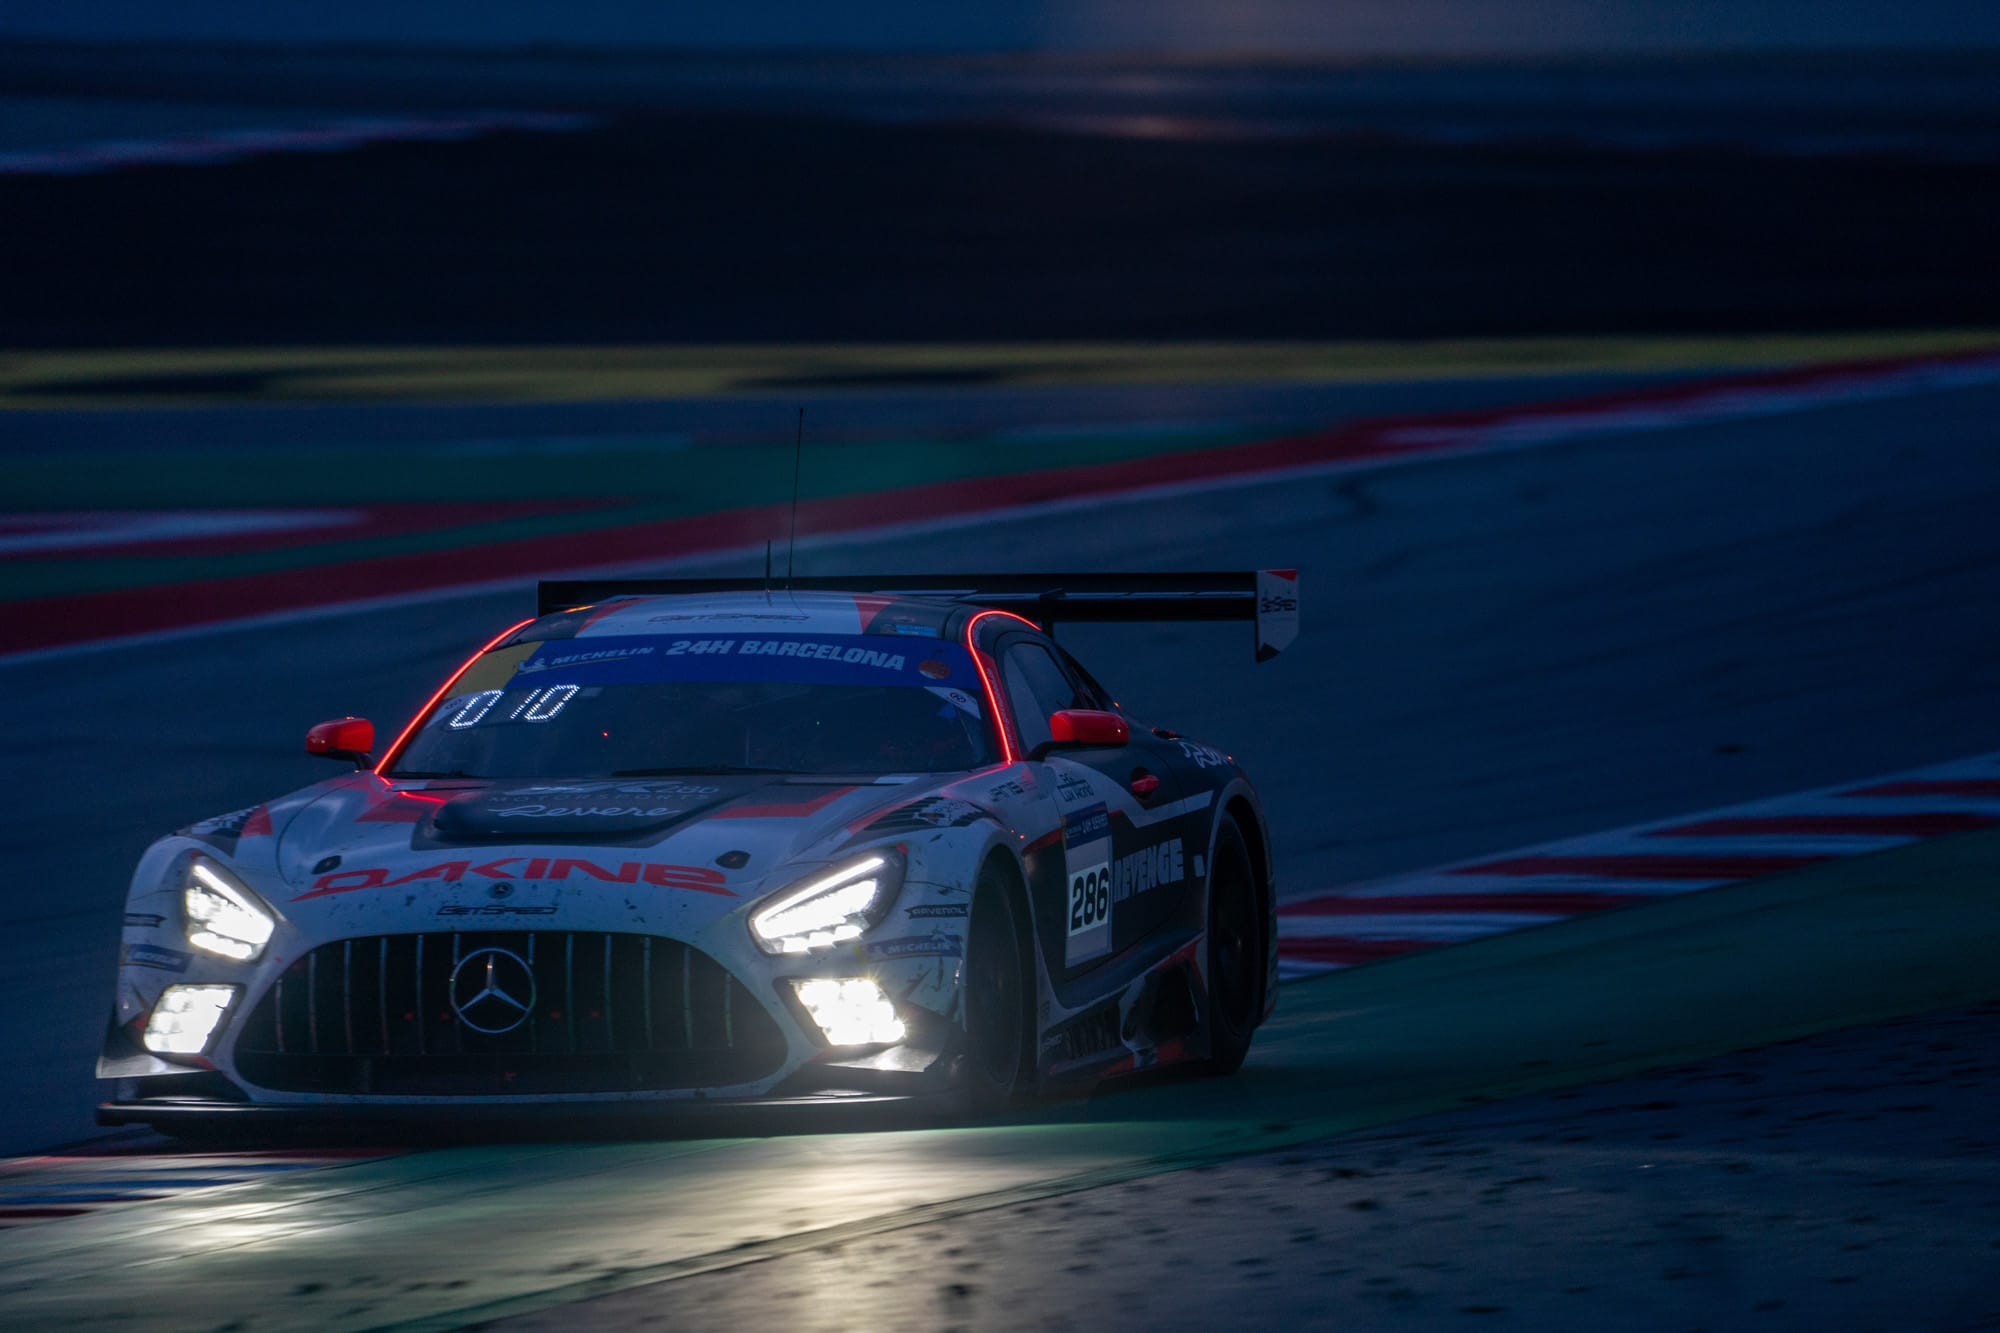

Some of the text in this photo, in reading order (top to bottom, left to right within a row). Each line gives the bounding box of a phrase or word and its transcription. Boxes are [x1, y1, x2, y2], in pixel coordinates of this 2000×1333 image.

[551, 646, 655, 666] MICHELIN
[665, 639, 907, 672] 24H BARCELONA
[487, 804, 681, 817] Revere
[292, 857, 740, 902] DAKINE
[1070, 867, 1110, 931] 286
